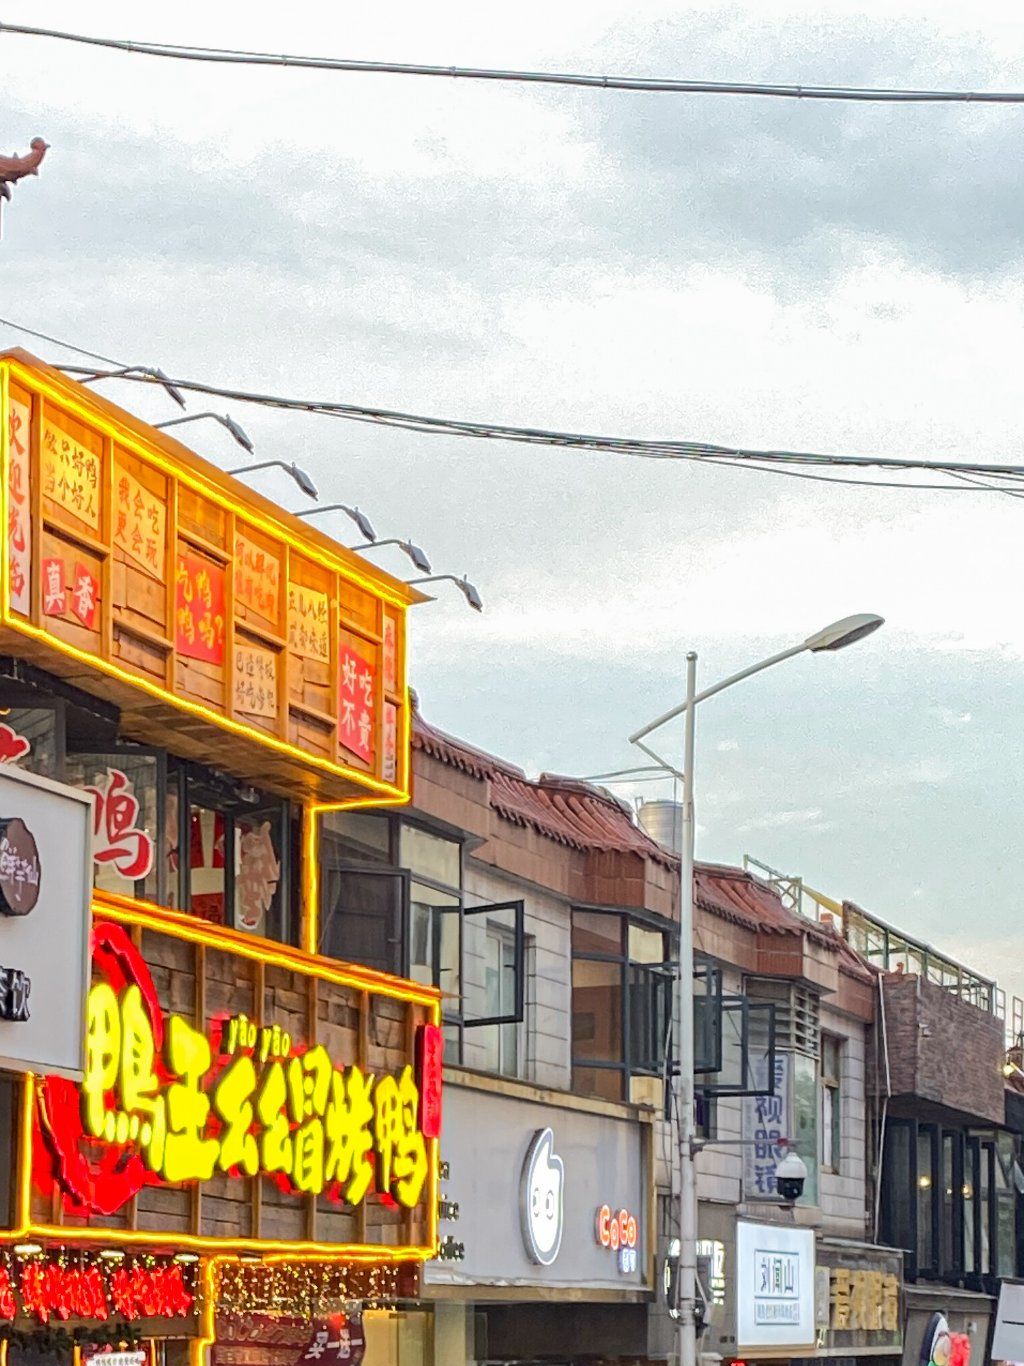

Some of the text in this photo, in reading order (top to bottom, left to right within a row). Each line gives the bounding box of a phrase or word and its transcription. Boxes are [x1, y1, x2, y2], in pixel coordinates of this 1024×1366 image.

[46, 562, 94, 618] 真香
[341, 653, 373, 708] 好吃
[341, 702, 372, 751] 不贵
